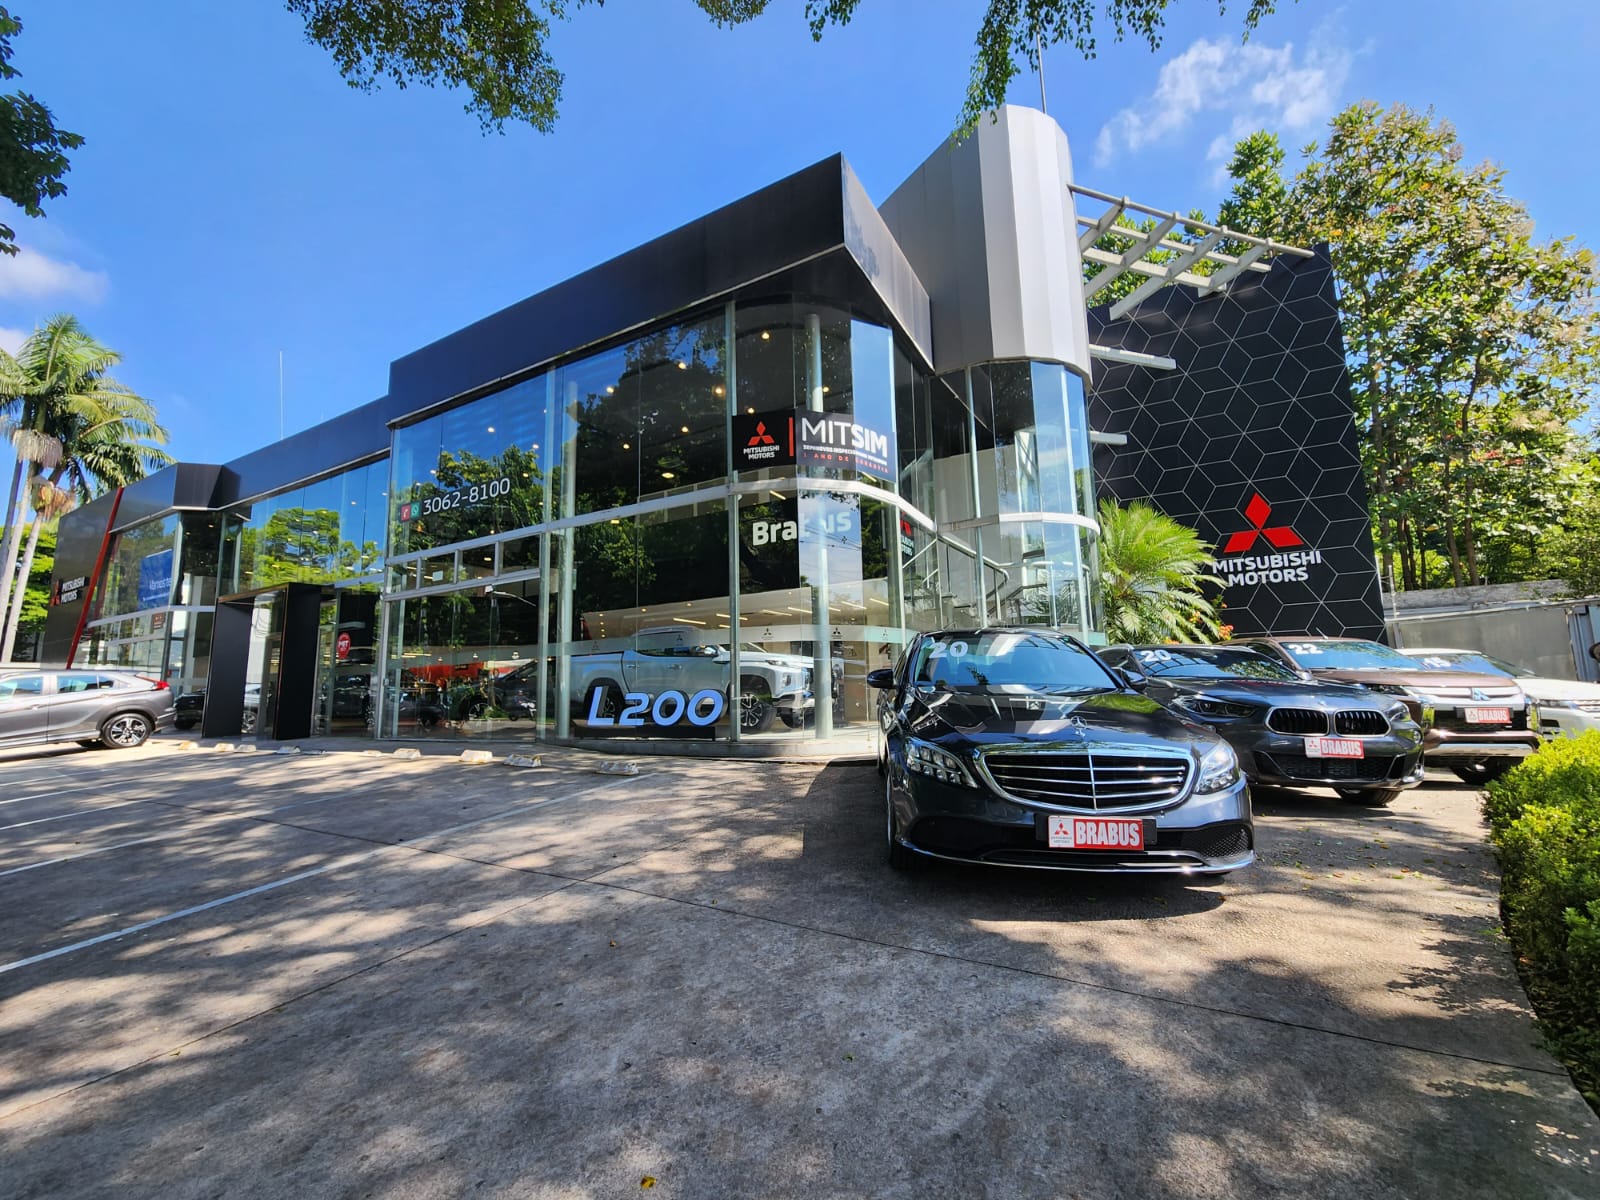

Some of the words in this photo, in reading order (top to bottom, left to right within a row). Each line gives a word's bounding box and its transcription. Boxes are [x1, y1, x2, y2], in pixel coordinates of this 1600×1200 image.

[802, 417, 888, 458] MITSIM
[743, 445, 780, 454] MITSUBISHI
[748, 451, 775, 460] MOTORS
[423, 478, 510, 515] 3062-8100
[1212, 550, 1322, 573] MITSUBISHI
[1228, 566, 1308, 587] MOTORS
[929, 641, 968, 658] 20
[1141, 650, 1171, 662] 20
[1288, 643, 1324, 655] 22
[587, 686, 723, 726] L200
[1479, 710, 1507, 721] BRABUS
[1322, 740, 1362, 756] BRABUS
[1075, 822, 1140, 846] BRABUS
